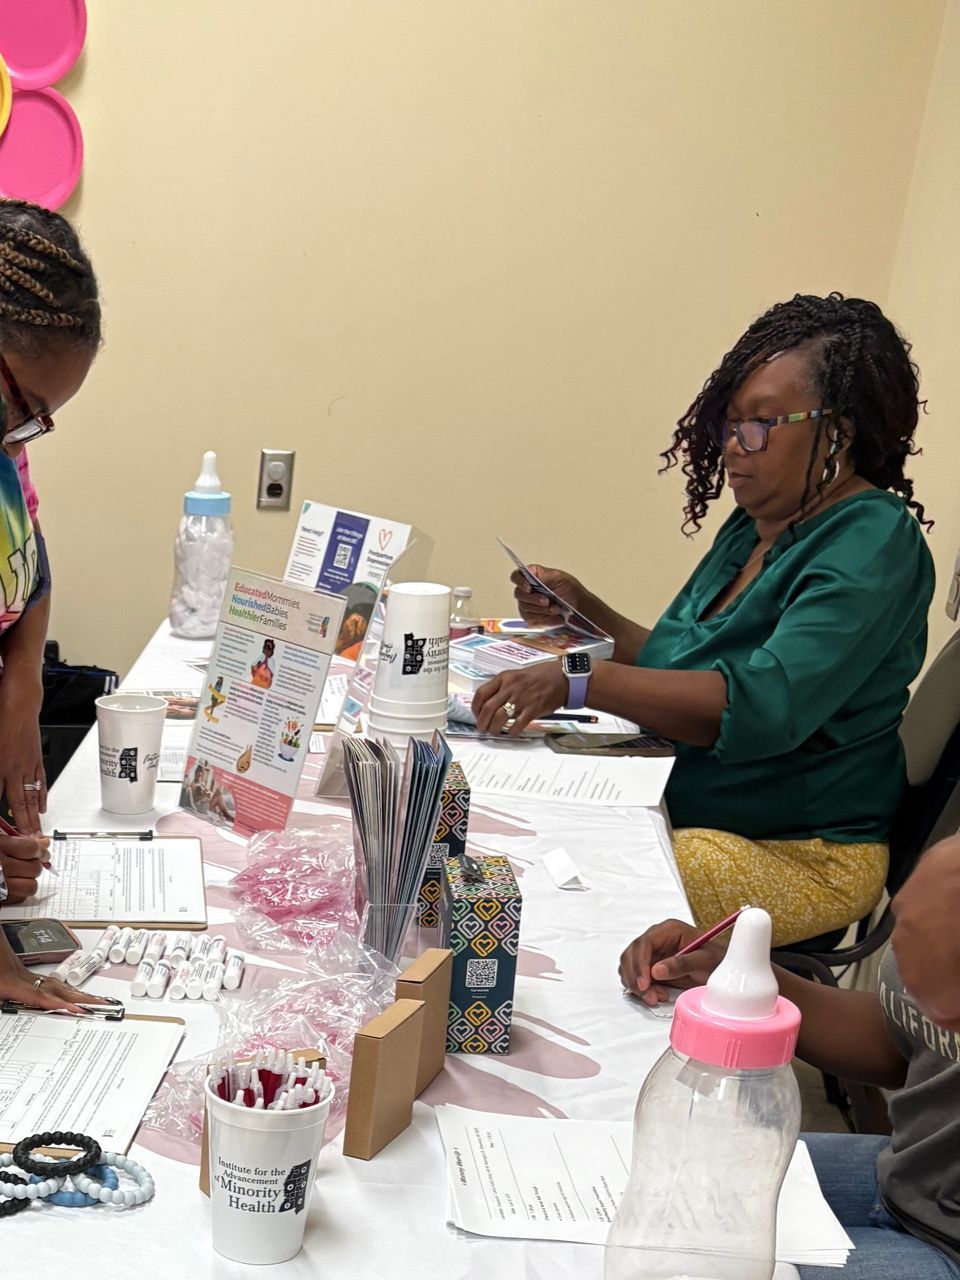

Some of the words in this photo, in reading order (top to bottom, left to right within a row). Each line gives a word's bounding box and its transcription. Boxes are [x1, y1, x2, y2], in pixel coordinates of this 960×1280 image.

[218, 1156, 252, 1175] Institute
[254, 1167, 268, 1177] for
[270, 1167, 286, 1177] the
[222, 1169, 278, 1186] Advancement
[220, 1175, 282, 1203] Minority
[228, 1195, 276, 1213] Health
